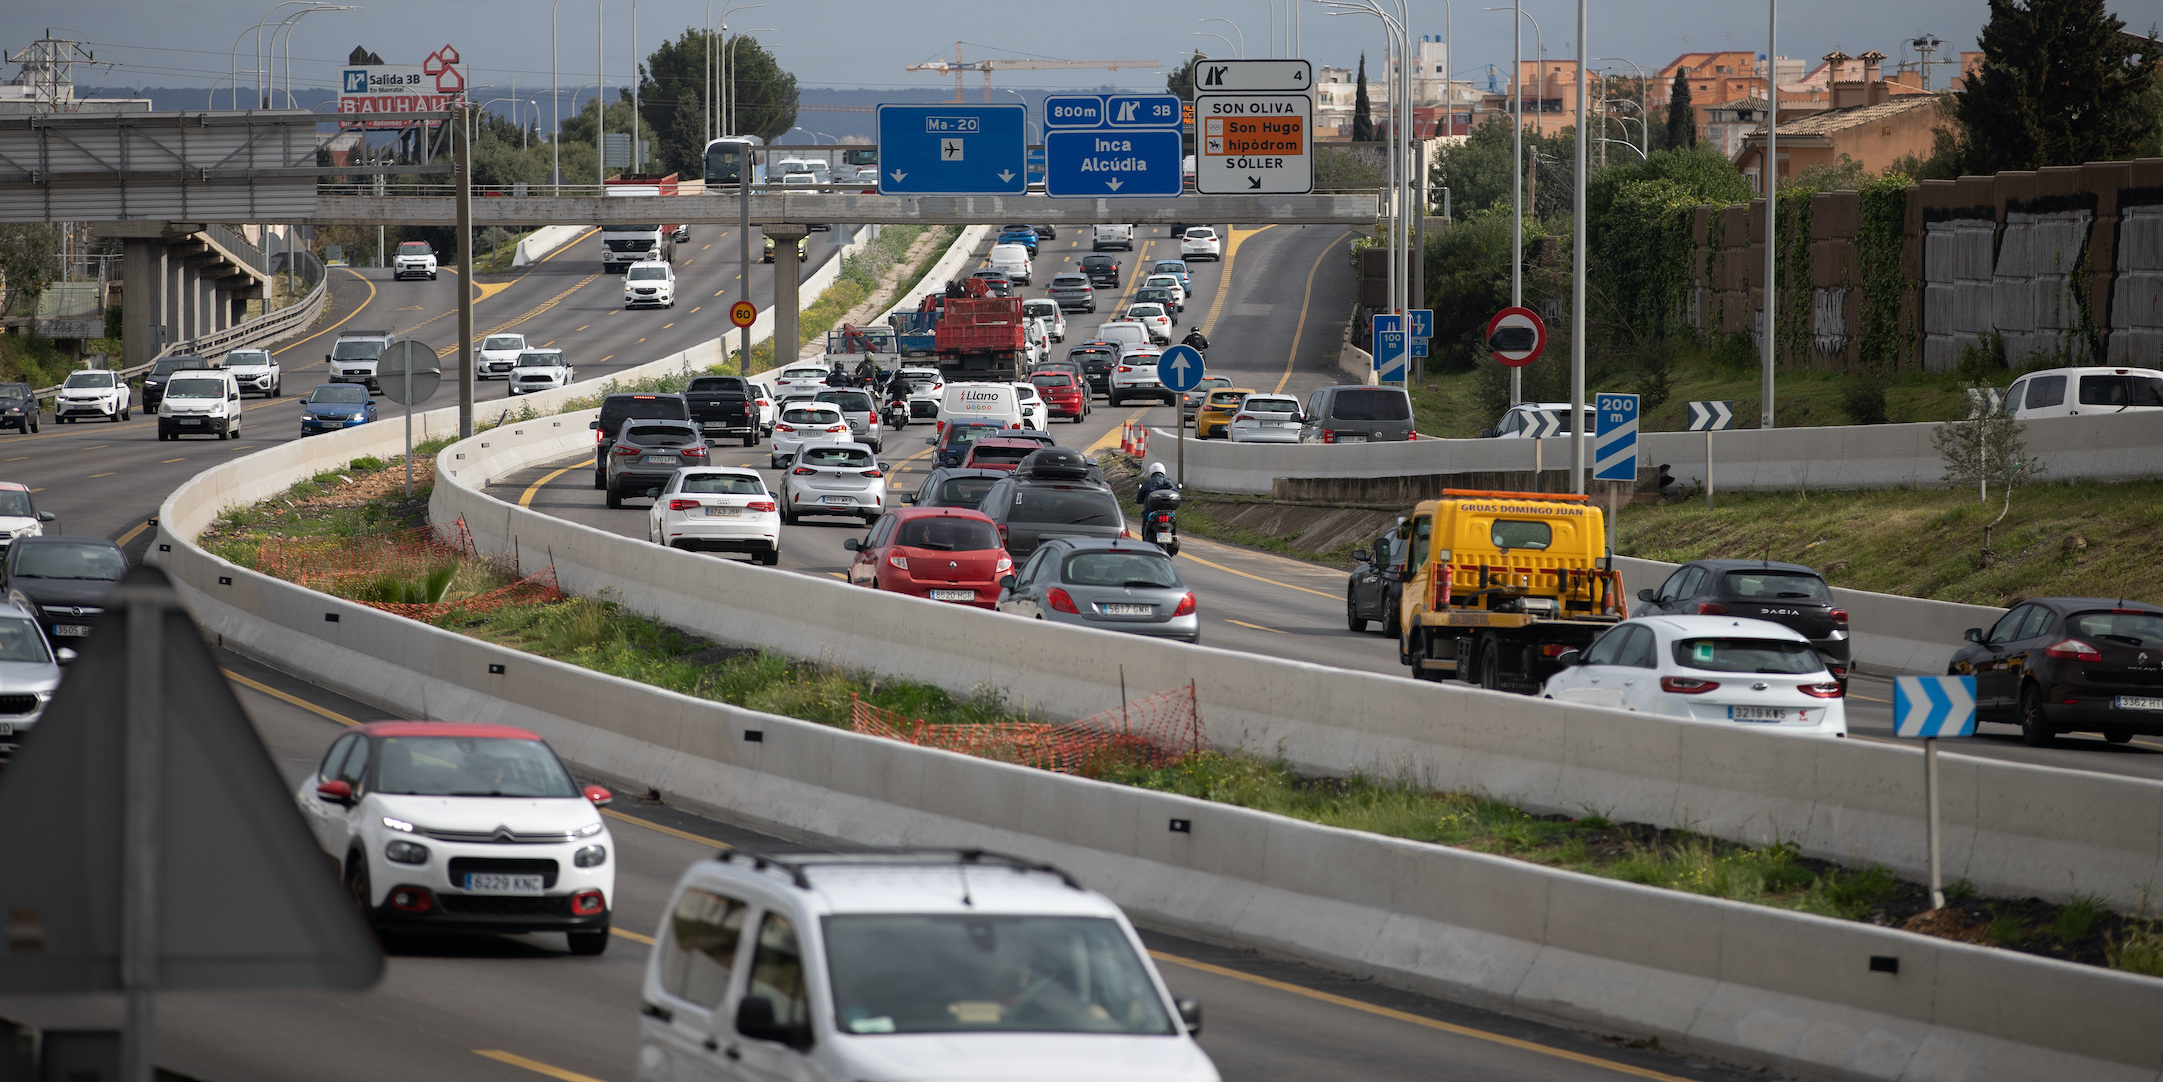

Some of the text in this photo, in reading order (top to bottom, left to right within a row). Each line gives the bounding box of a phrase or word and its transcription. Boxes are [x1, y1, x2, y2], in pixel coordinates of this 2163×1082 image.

[369, 74, 421, 85] Salida 3B
[1293, 70, 1303, 81] 4
[1054, 106, 1097, 118] 800m
[1152, 105, 1171, 117] 3B
[1212, 102, 1294, 114] SON OLIVA
[1229, 122, 1300, 135] Son Hugo
[1095, 138, 1132, 152] Inca
[1229, 139, 1298, 153] hipòdrom
[1080, 157, 1148, 172] Alcúdia
[1226, 155, 1283, 169] SÓLLER
[736, 309, 751, 319] 60
[1384, 334, 1402, 342] 100
[966, 390, 999, 401] Llano
[1602, 398, 1634, 412] 200
[1610, 413, 1624, 423] m
[1461, 504, 1583, 516] GRUAS DOMINGO JUAN
[1109, 604, 1130, 613] 5617
[1761, 608, 1800, 616] DACIA
[2122, 697, 2147, 707] 3362
[1736, 707, 1763, 718] 3219
